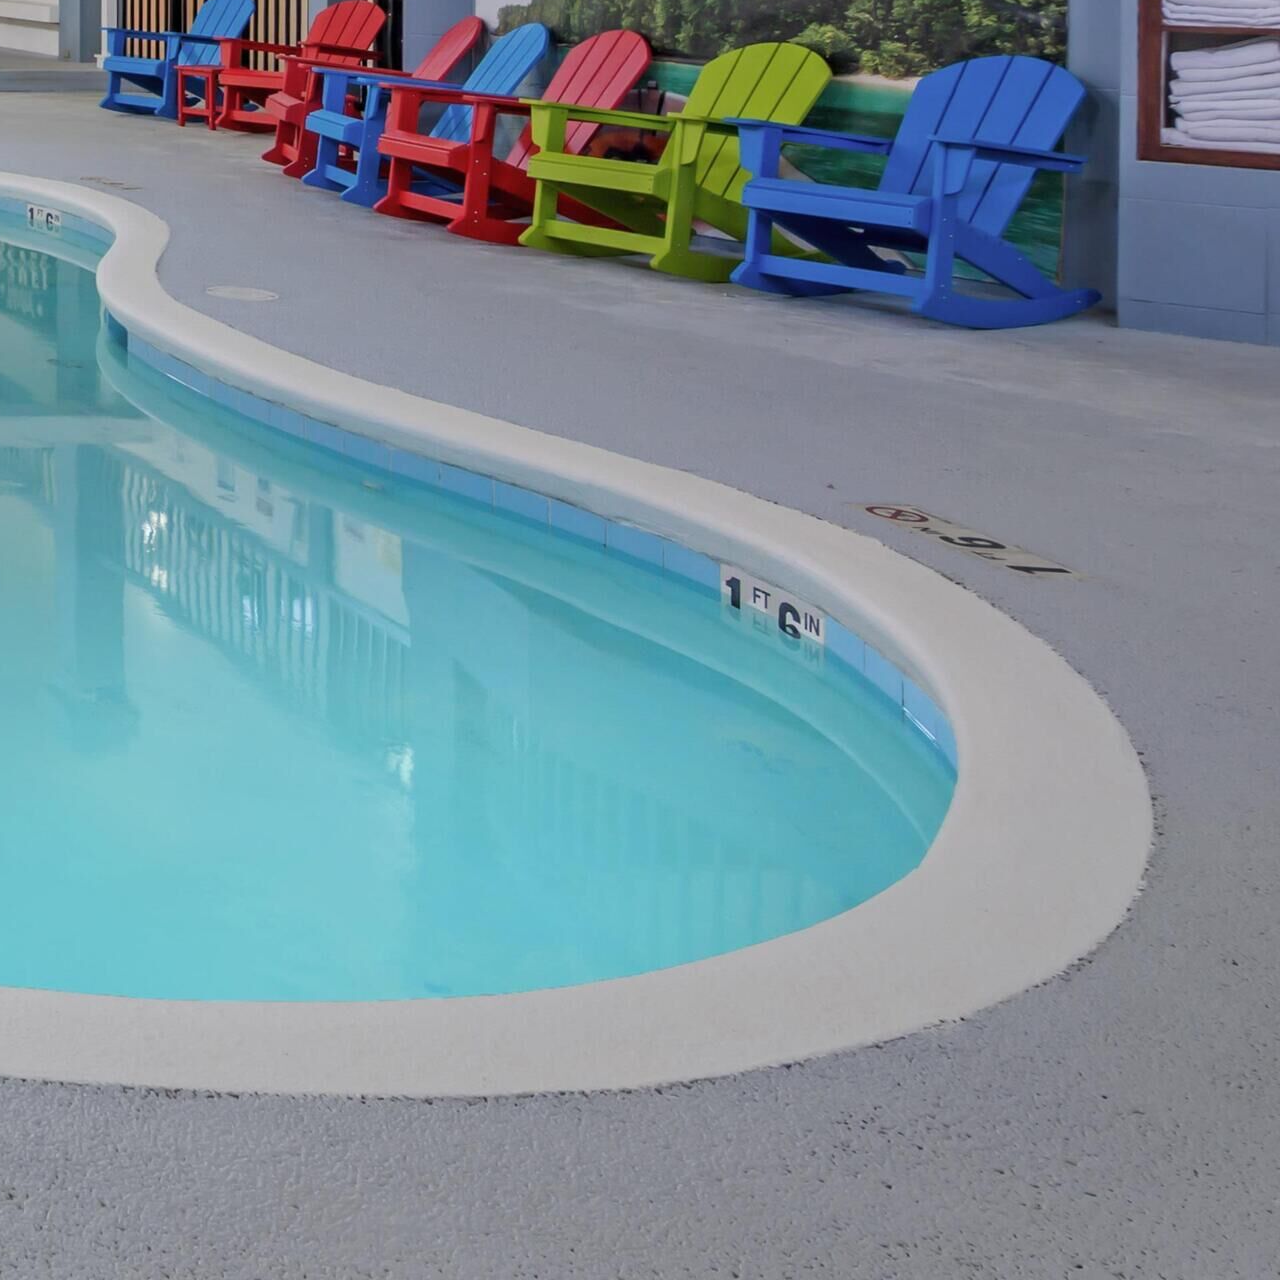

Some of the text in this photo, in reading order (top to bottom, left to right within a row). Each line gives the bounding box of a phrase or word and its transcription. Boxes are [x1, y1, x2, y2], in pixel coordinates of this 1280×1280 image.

[726, 576, 820, 639] 1 FT 6 IN
